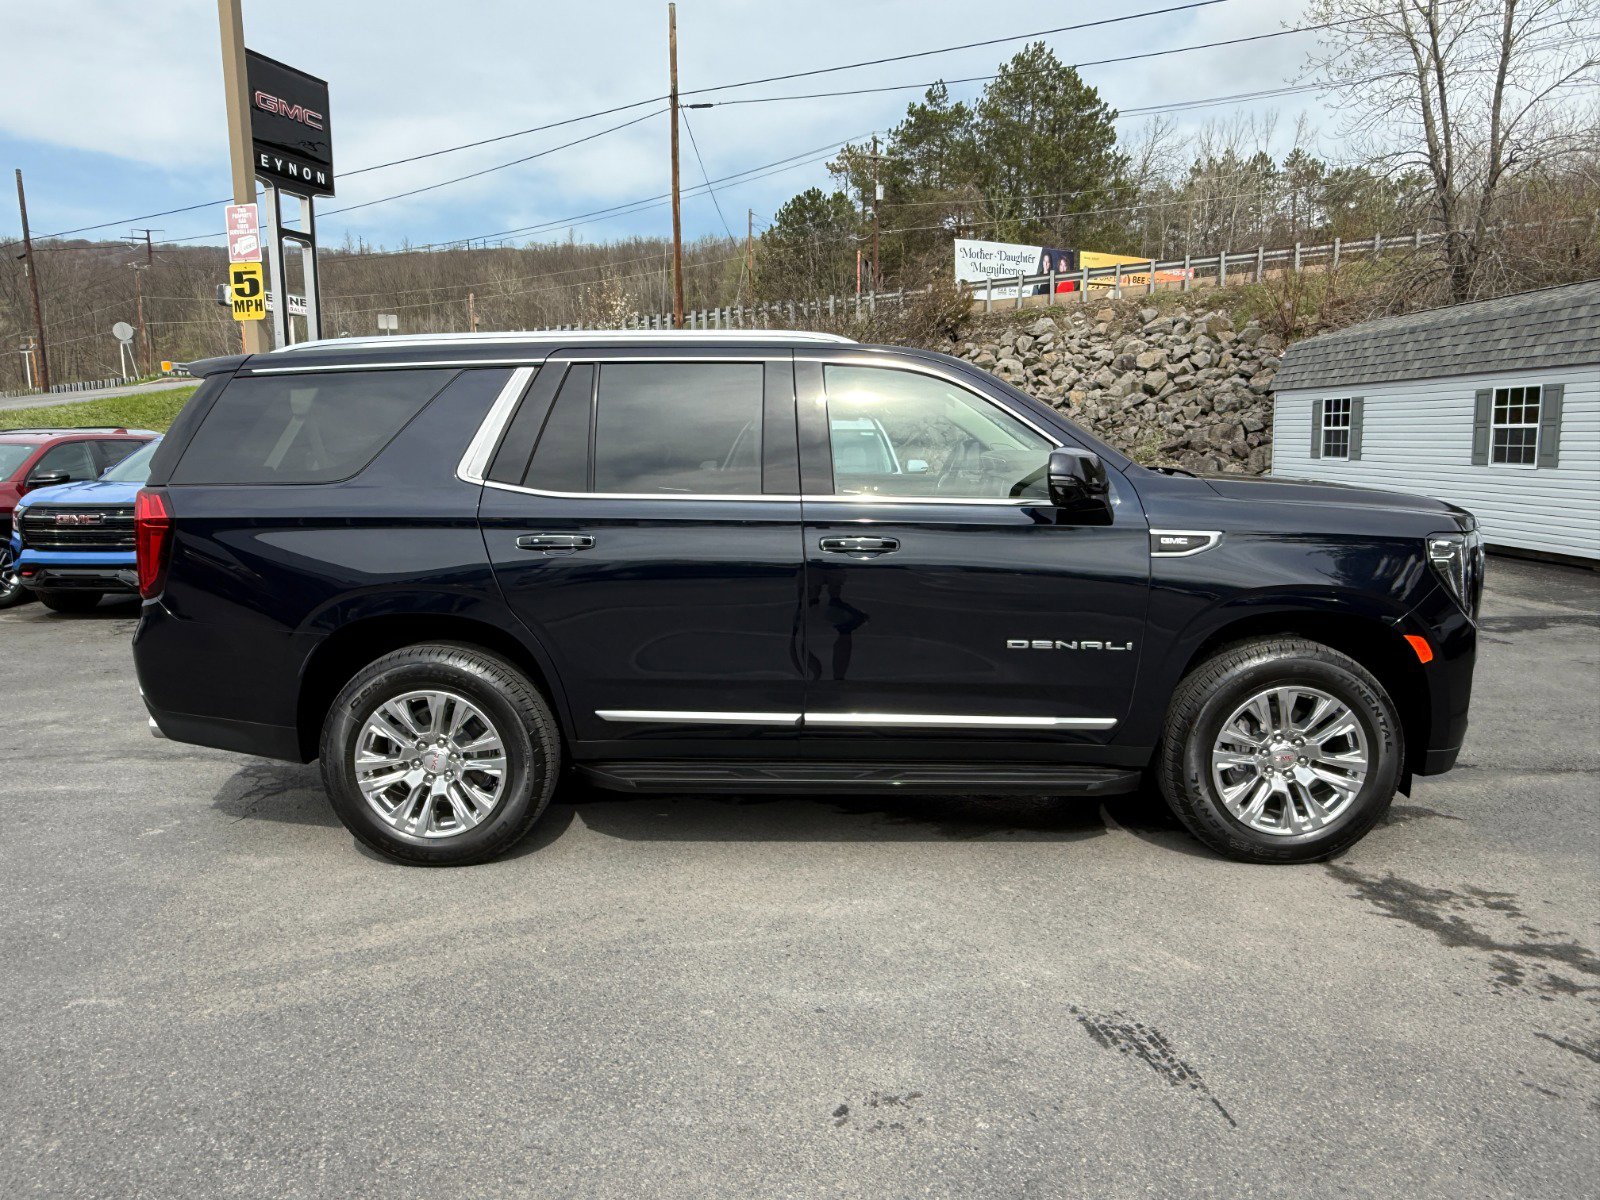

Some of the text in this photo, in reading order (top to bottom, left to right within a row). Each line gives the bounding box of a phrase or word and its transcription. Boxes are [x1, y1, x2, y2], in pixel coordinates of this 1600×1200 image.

[255, 90, 322, 131] GMC
[260, 153, 325, 184] EYNON
[233, 270, 260, 298] 5
[234, 299, 263, 313] MPH
[55, 514, 101, 525] GMC
[1160, 537, 1188, 545] GMC
[1006, 639, 1133, 651] DENALI
